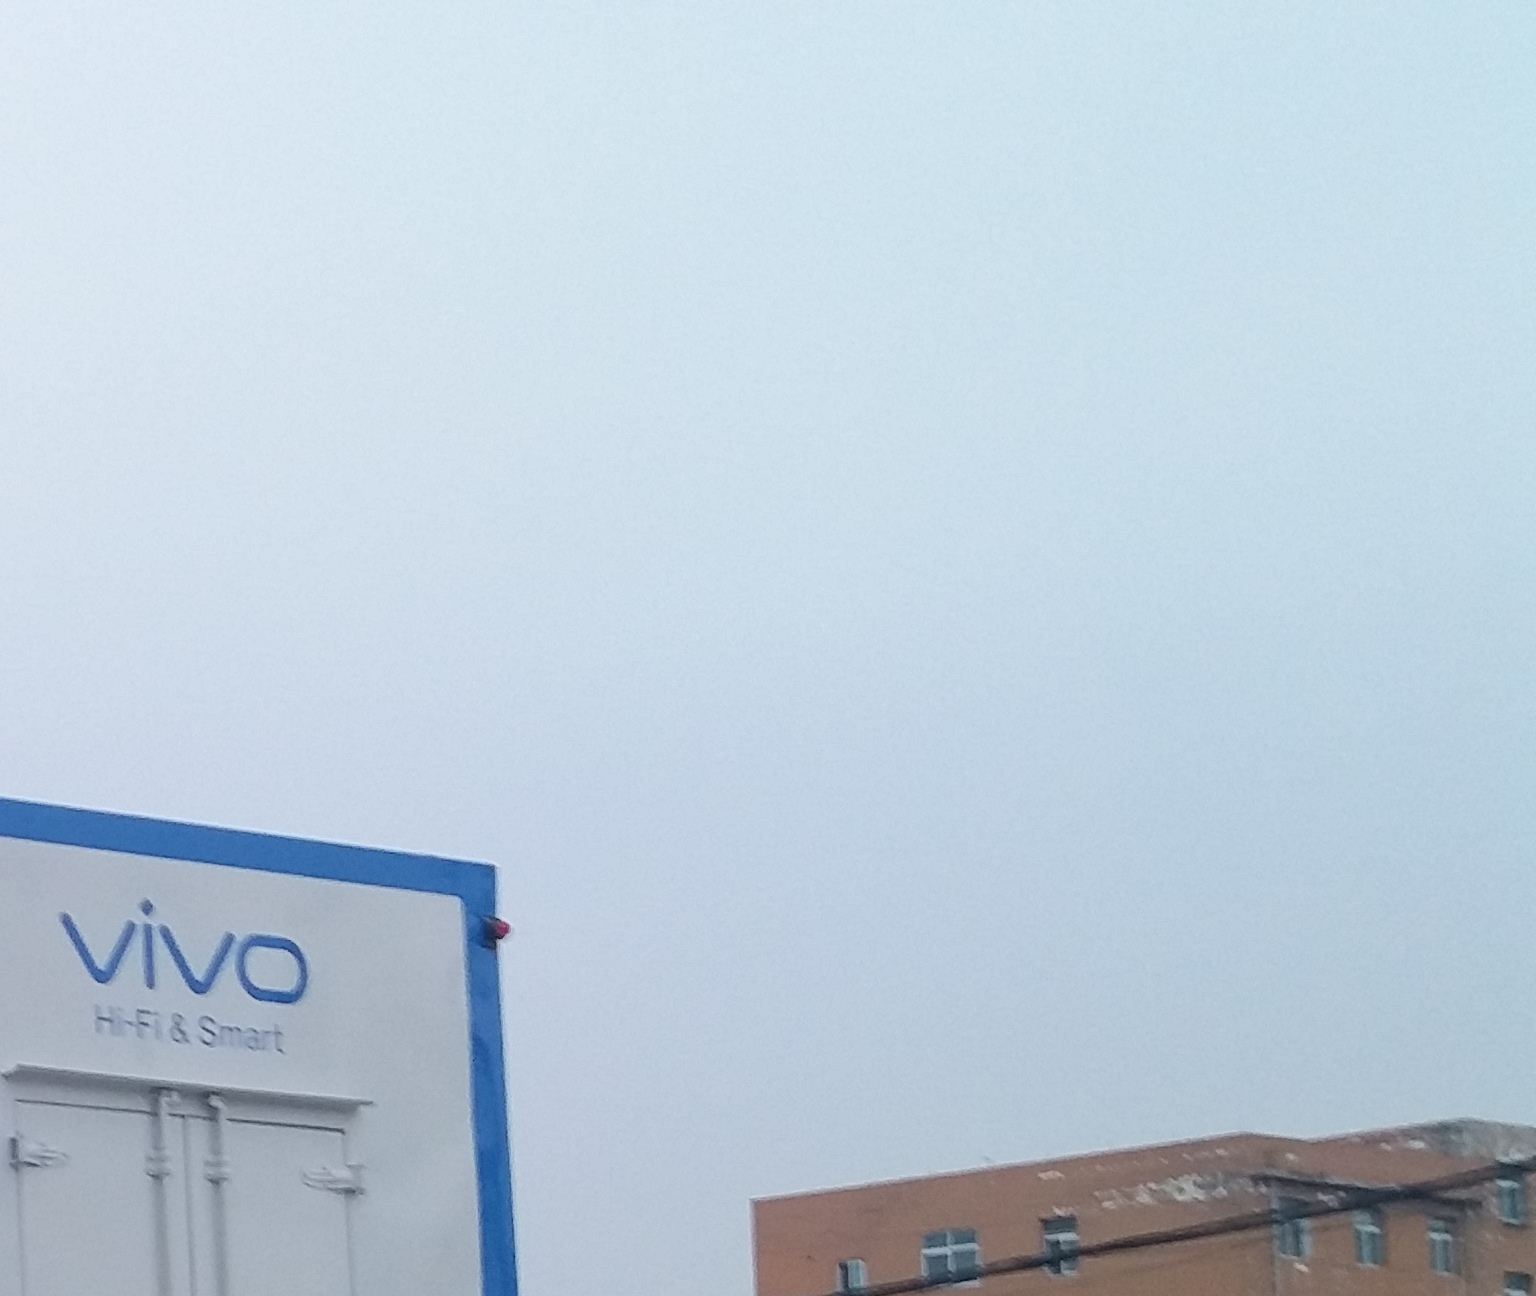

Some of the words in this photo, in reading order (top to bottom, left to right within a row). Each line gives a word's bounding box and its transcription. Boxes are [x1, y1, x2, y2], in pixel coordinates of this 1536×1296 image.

[93, 1003, 163, 1038] Hi-Fi
[169, 1012, 191, 1044] &
[198, 1013, 287, 1055] Smart
